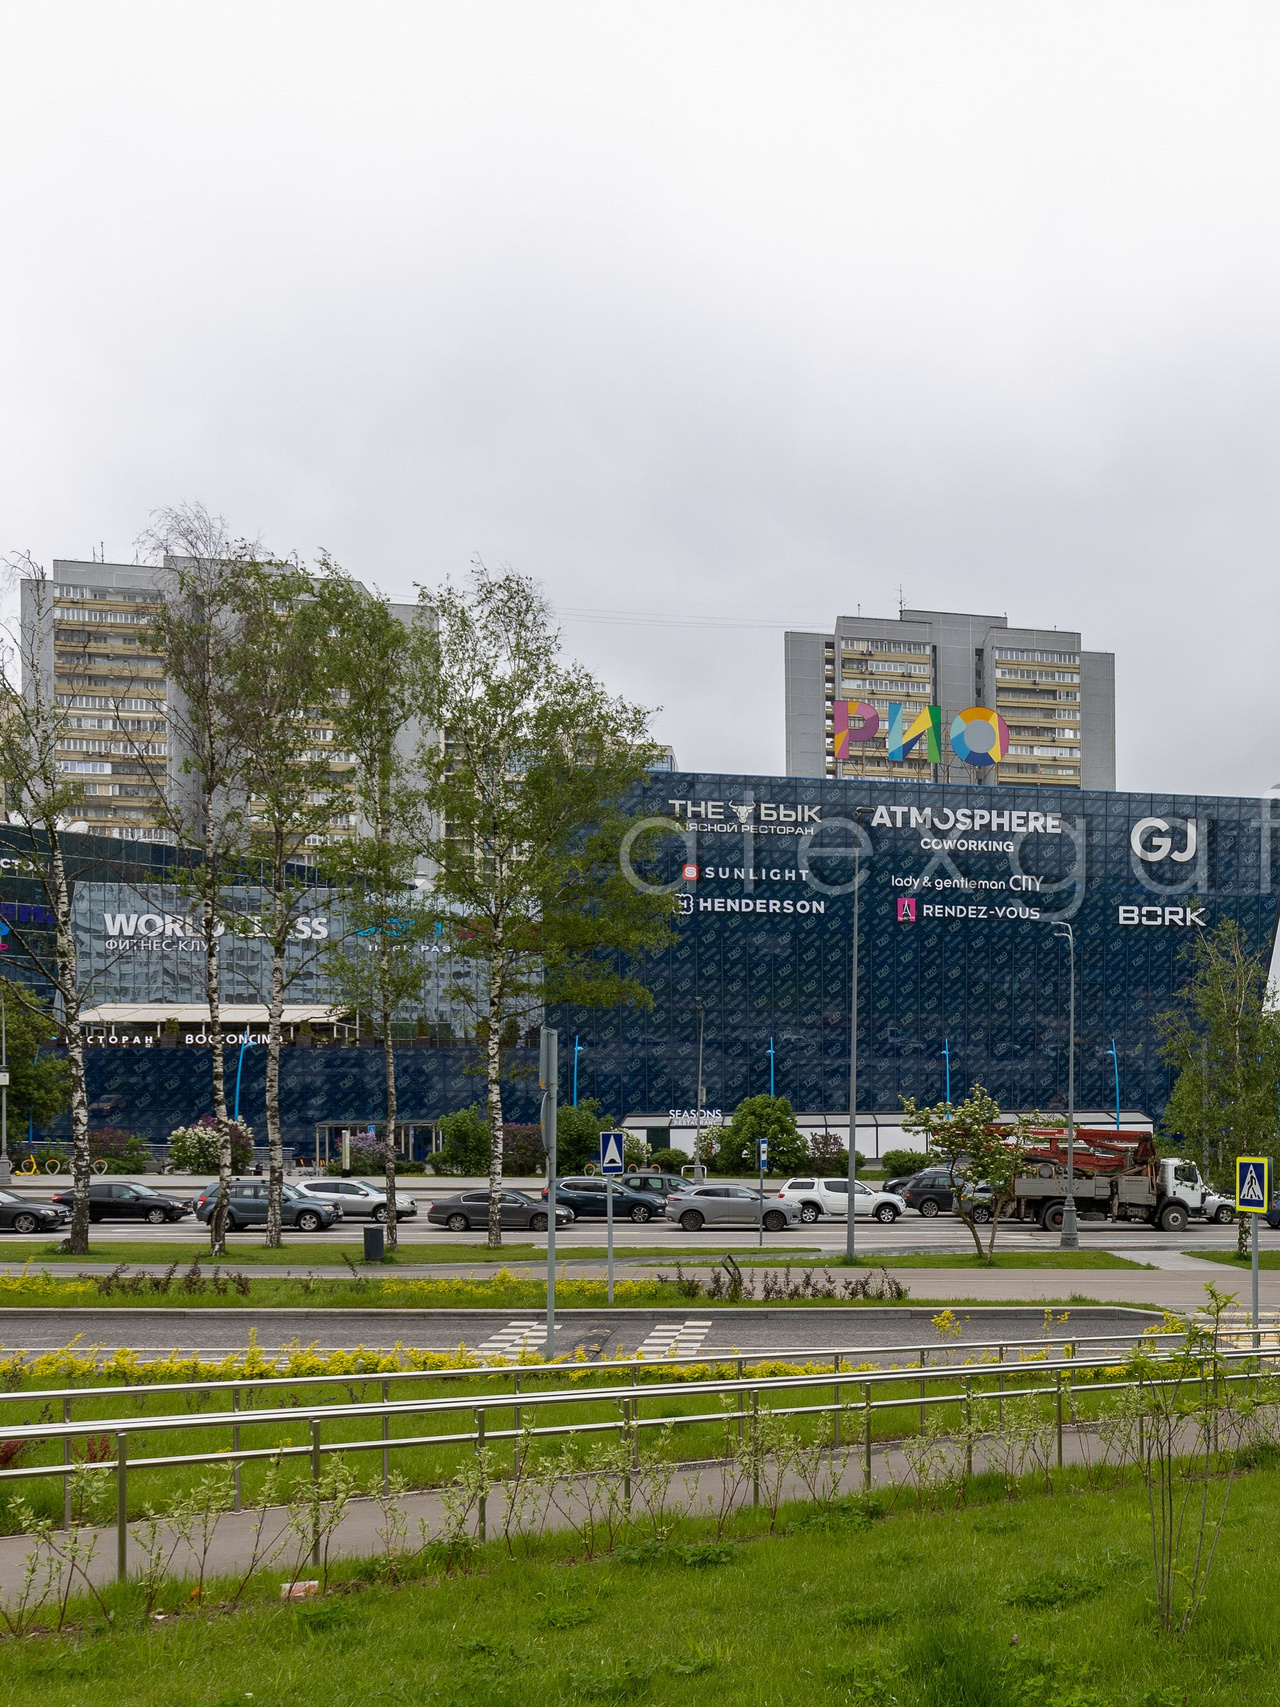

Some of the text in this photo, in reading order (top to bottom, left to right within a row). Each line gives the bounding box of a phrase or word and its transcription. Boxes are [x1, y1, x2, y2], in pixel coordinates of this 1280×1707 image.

[834, 700, 1010, 767] РИО
[668, 799, 822, 823] THE БЫК
[871, 805, 1062, 834] ATMOSPHERE
[675, 821, 814, 836] МЯСНОЙ РЕСТОРАН
[920, 837, 1015, 853] COWORKING
[1130, 816, 1197, 862] GJ
[705, 866, 809, 882] SUNLIGHT
[891, 874, 920, 890] lady
[935, 876, 1006, 891] gentleman
[1009, 874, 1044, 892] CITY
[699, 898, 825, 914] HENDERSON
[923, 904, 1041, 919] RENDEZ-VOUS
[1118, 905, 1207, 927] BORK
[103, 913, 225, 937] WORLD
[235, 915, 329, 940] LSS
[65, 1033, 283, 1044] СТОРАН BOCONCIN
[668, 1109, 722, 1119] SEASONS
